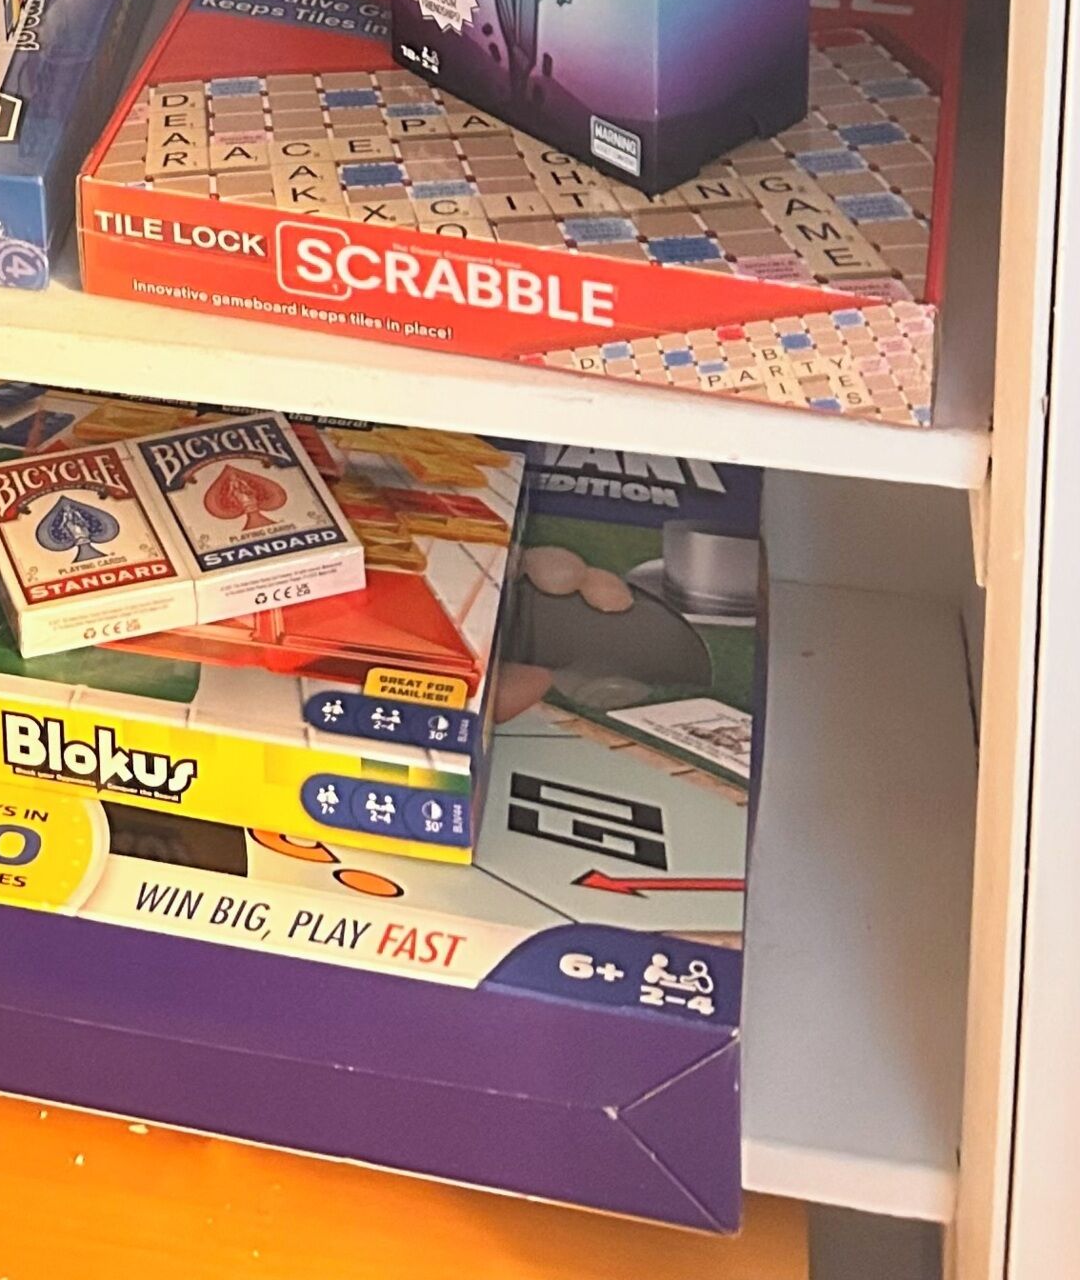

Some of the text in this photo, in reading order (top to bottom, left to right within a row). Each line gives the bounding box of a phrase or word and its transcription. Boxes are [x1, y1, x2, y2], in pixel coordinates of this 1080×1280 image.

[94, 211, 266, 256] TILE LOCK
[296, 237, 614, 326] SCRABBLE
[134, 280, 452, 341] Innovative gameboard keeps tiles in place!
[153, 425, 289, 487] BICYCLE
[204, 529, 338, 567] STANDARD
[30, 561, 168, 600] STANDARD
[6, 713, 196, 793] Blokus
[23, 806, 48, 822] IN
[135, 882, 467, 967] WIN BIG, PLAY FAST
[560, 955, 624, 981] 6+
